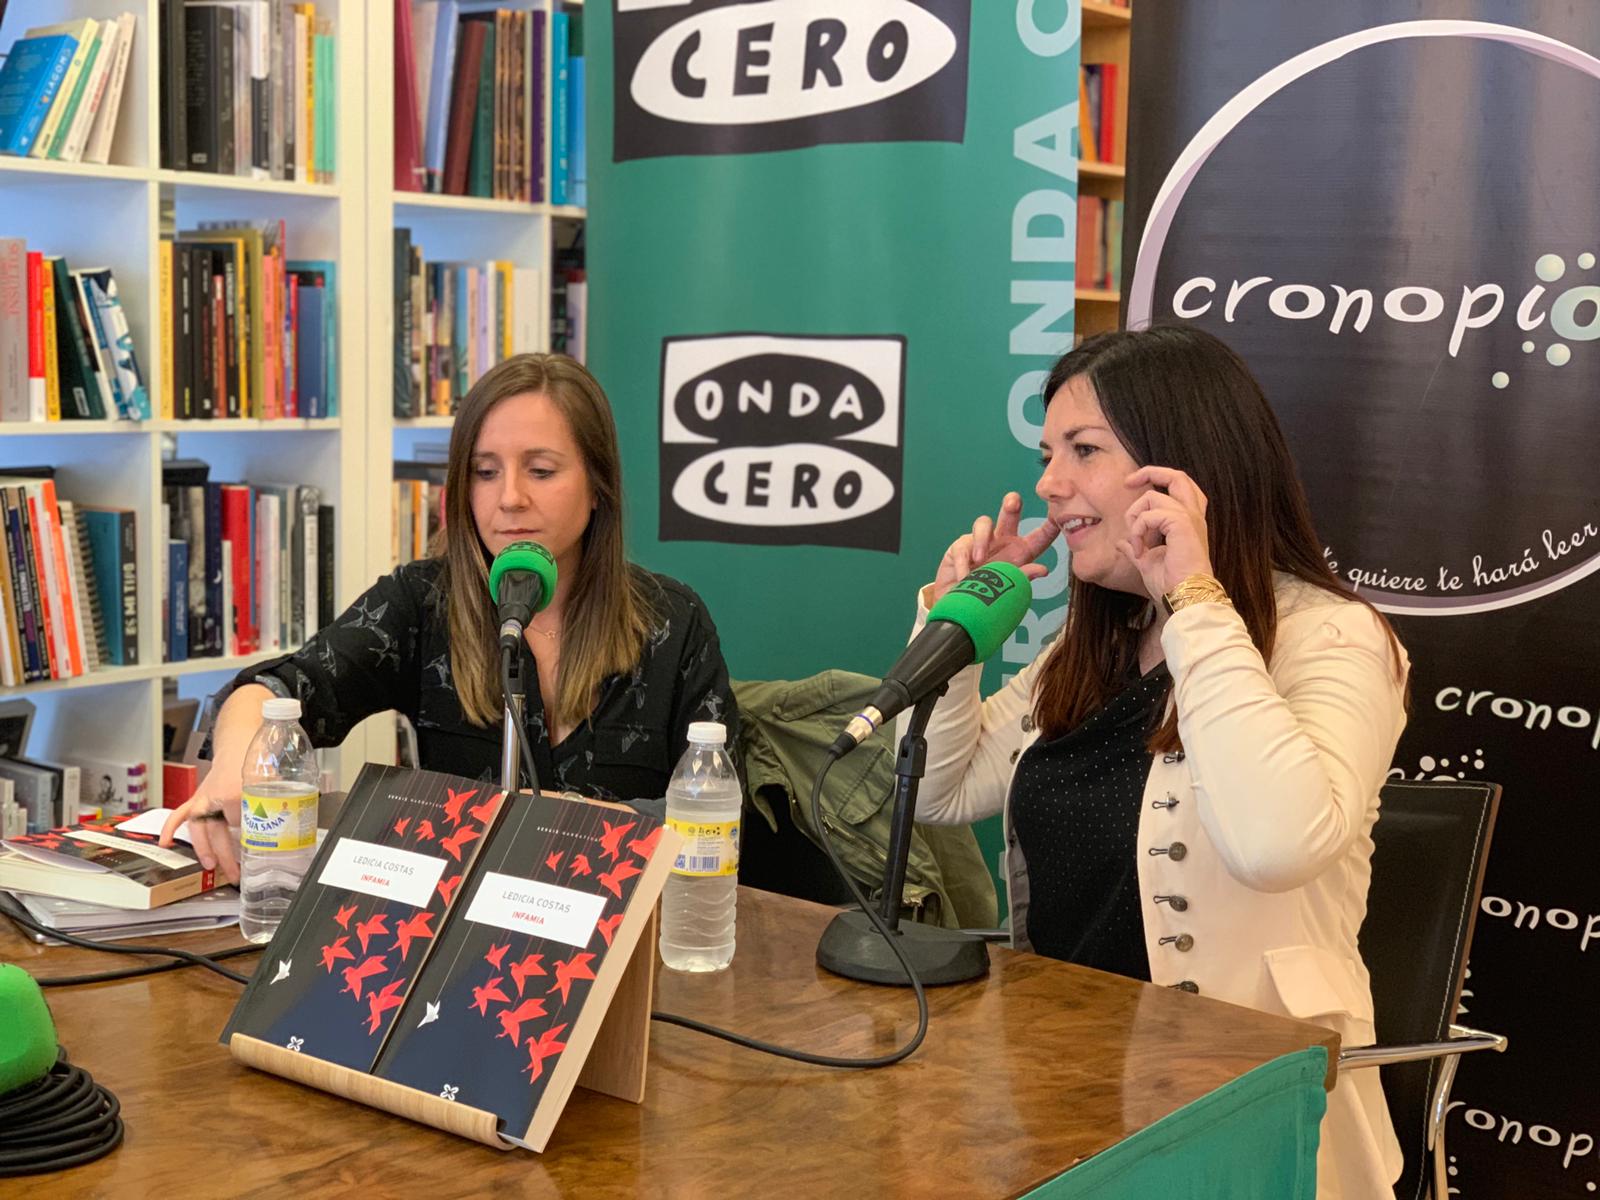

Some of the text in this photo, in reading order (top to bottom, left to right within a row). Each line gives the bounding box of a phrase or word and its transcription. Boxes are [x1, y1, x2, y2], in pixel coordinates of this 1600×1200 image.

[671, 19, 909, 98] CERO
[1172, 276, 1600, 358] cronopio
[694, 379, 864, 421] ONDA
[703, 460, 863, 510] CERO
[1348, 567, 1427, 592] quiere
[1437, 566, 1464, 591] te
[1472, 548, 1540, 587] hará
[1542, 522, 1598, 561] leer
[1435, 686, 1600, 750] crono
[260, 817, 285, 831] SANA
[353, 855, 414, 876] LEDICIA COSTAS
[360, 874, 390, 888] INFAMIA
[502, 890, 571, 913] LEDICIA COSTAS
[512, 910, 545, 925] INFAMIA
